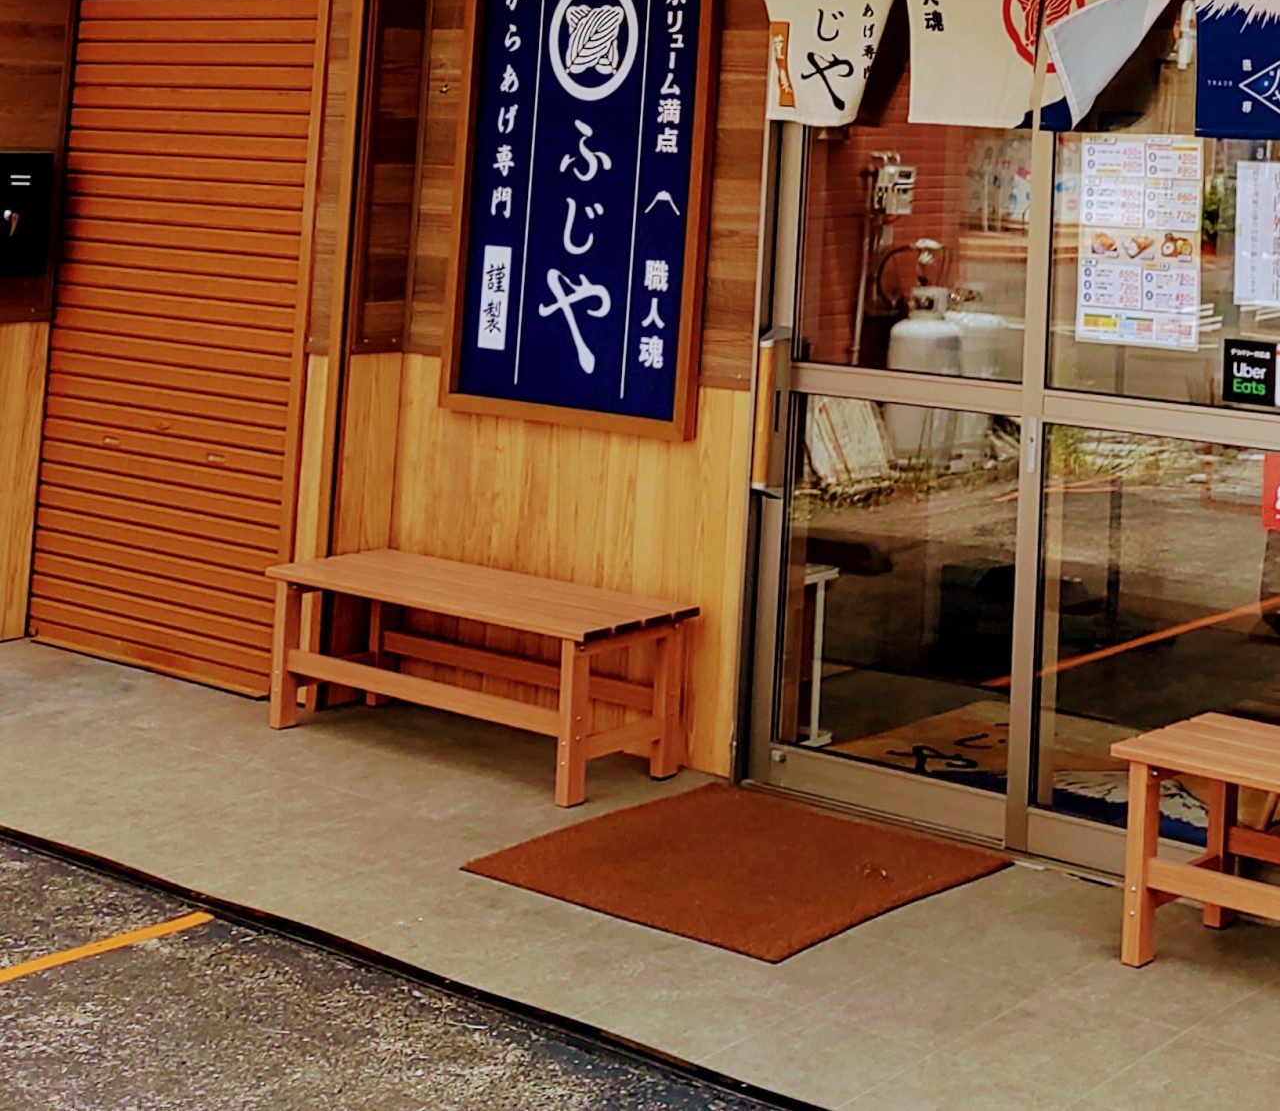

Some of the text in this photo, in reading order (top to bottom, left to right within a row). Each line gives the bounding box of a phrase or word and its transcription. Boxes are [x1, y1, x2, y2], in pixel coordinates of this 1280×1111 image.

[538, 119, 612, 374] ふじや
[638, 259, 669, 369] 職人魂
[1233, 361, 1267, 379] Uber
[1233, 378, 1267, 395] Eats
